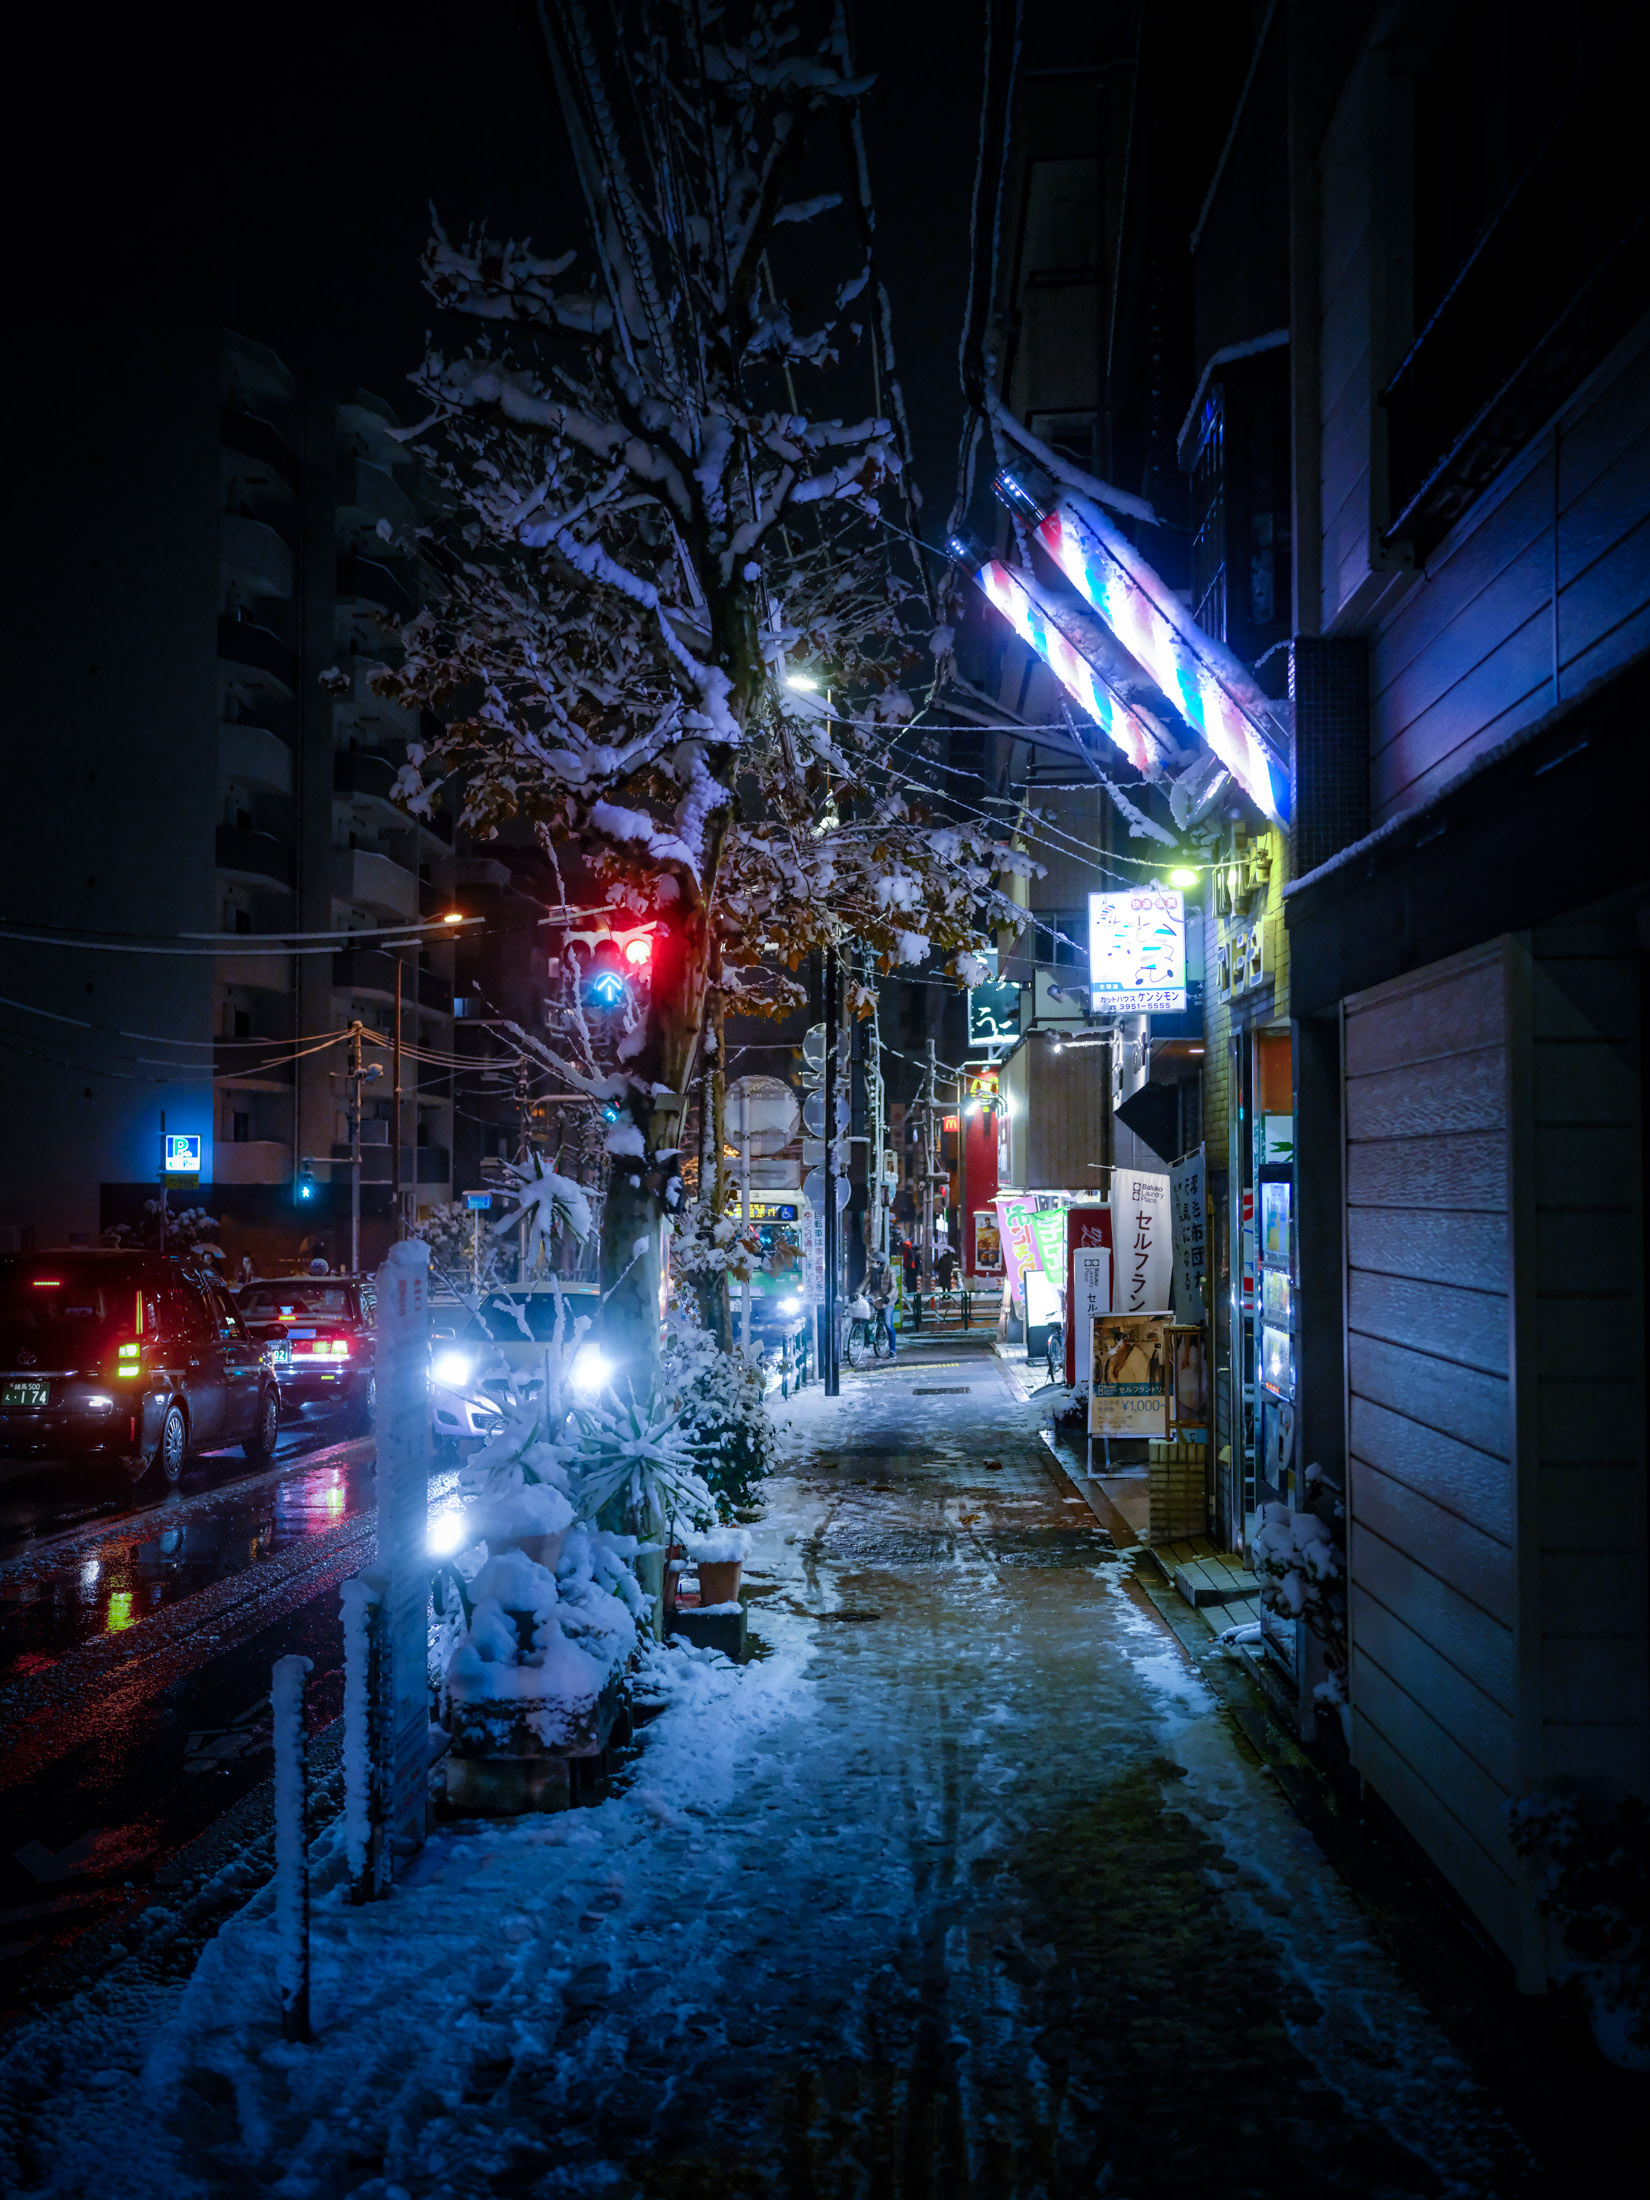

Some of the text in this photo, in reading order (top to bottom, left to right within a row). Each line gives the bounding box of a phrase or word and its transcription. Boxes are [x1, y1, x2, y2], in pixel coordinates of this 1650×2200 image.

[1100, 991, 1179, 1003] カットハウス ケンシモン
[1119, 1002, 1171, 1010] 3951-5555
[173, 1138, 188, 1156] P
[1142, 1184, 1163, 1192] Baluko
[1141, 1189, 1165, 1199] Laundry
[1141, 1196, 1157, 1204] Place
[1128, 1210, 1153, 1312] セルフラン
